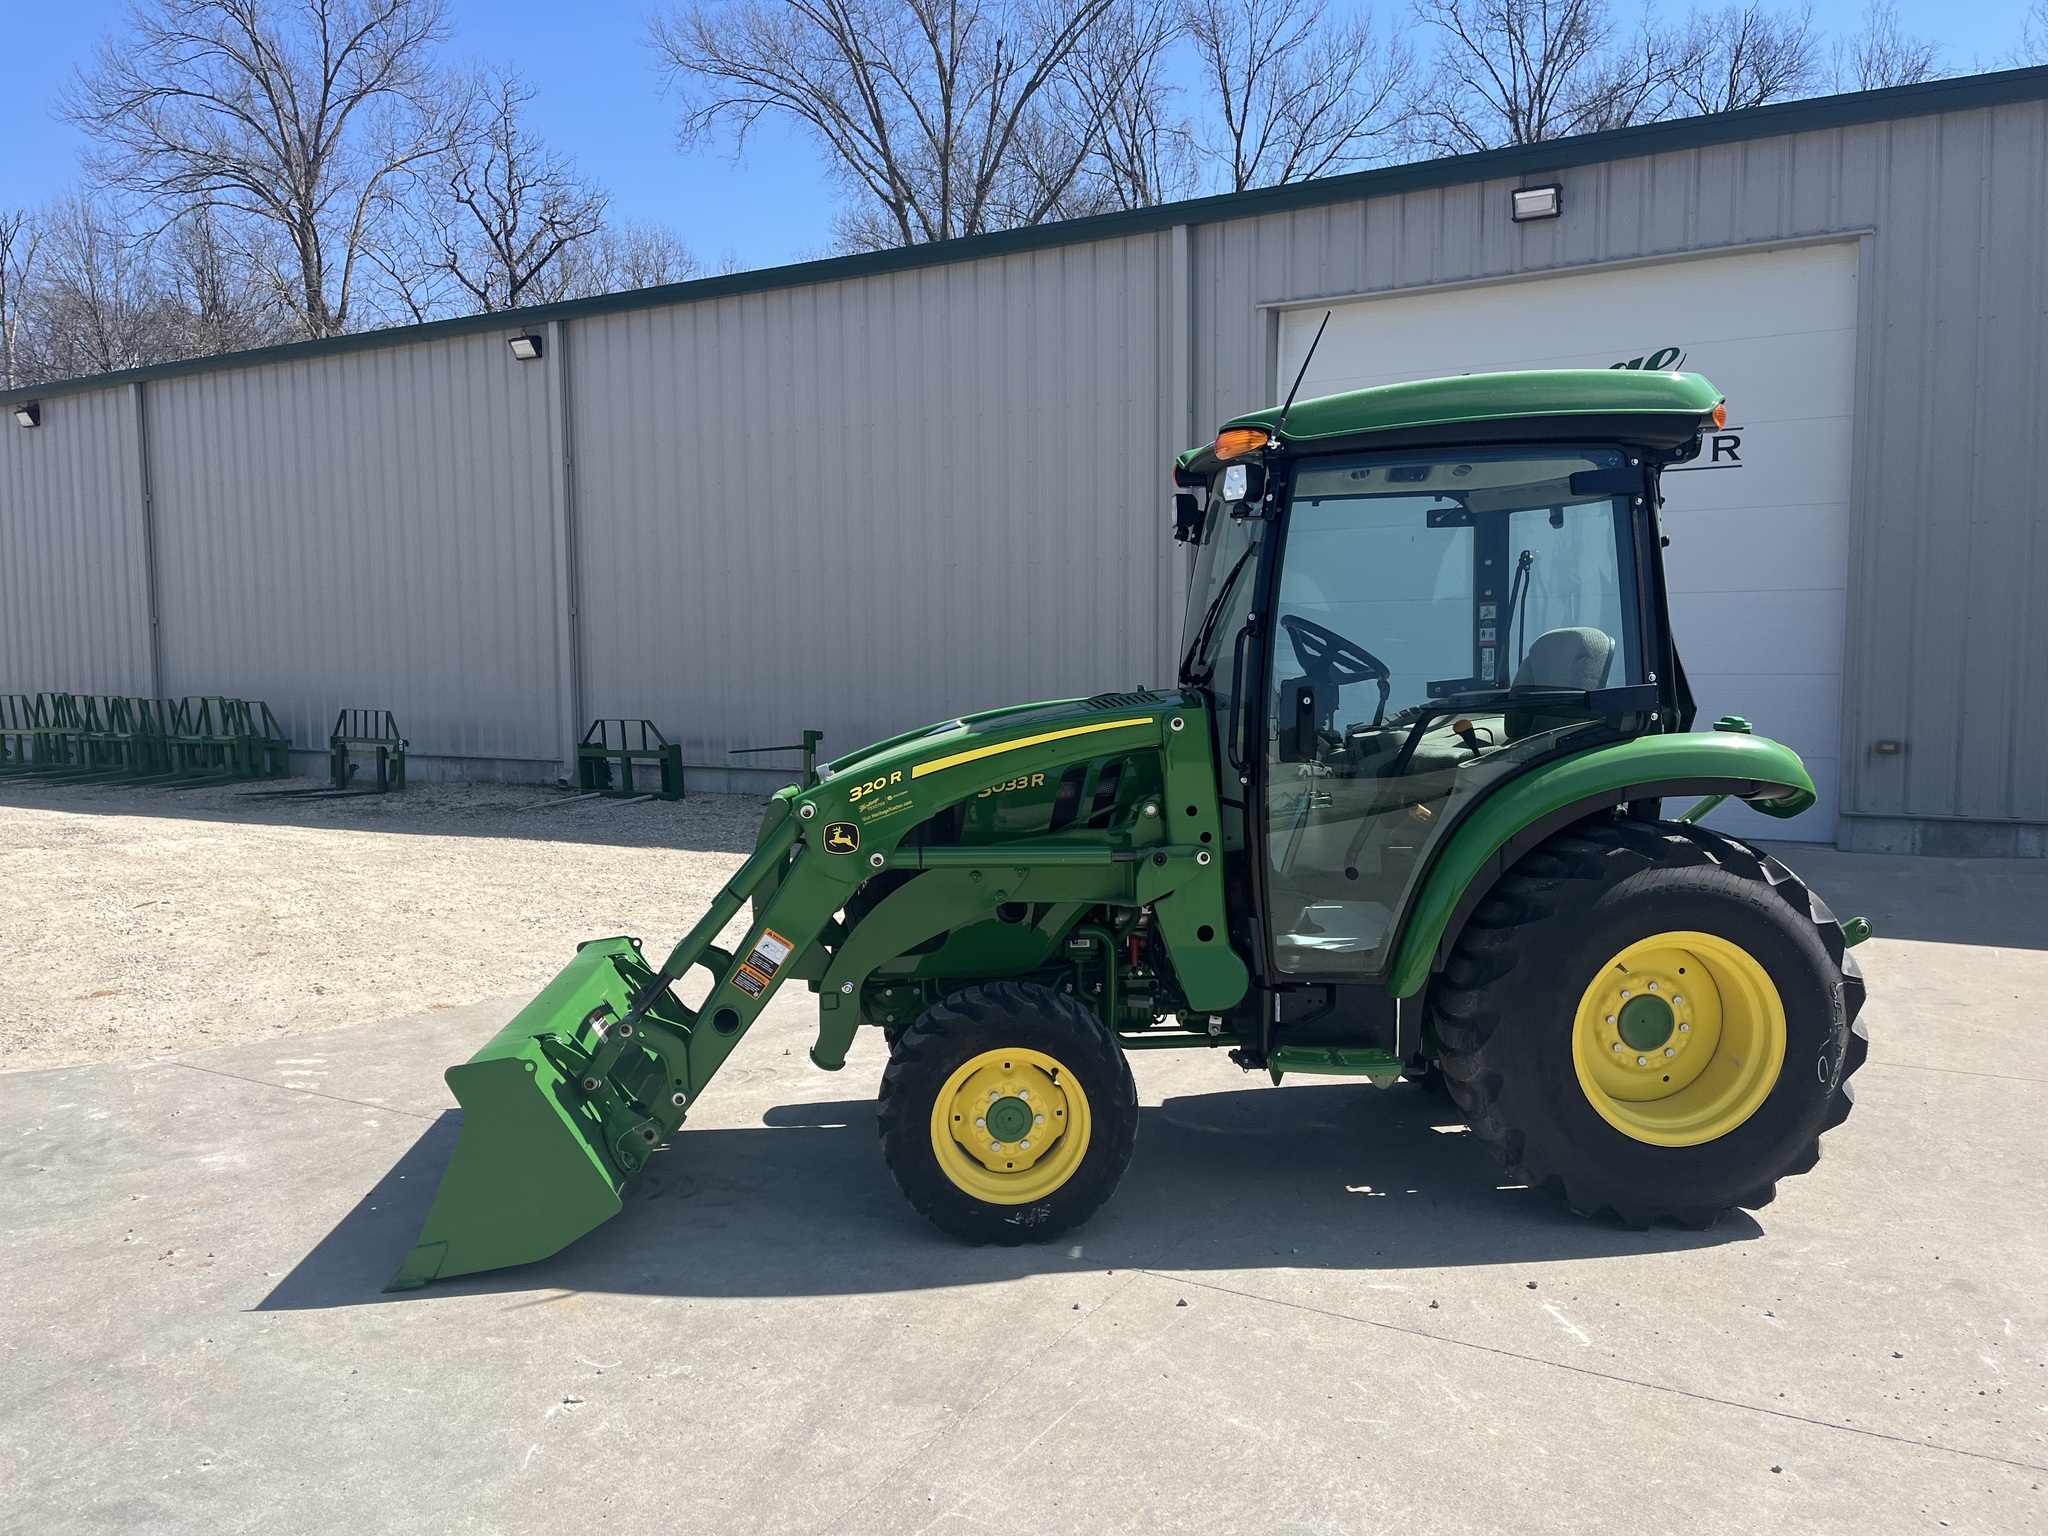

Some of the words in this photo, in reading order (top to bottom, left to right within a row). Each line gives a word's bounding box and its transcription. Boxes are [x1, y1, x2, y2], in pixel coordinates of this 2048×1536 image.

[849, 777, 887, 803] 320
[890, 770, 902, 785] R
[1031, 773, 1045, 788] R
